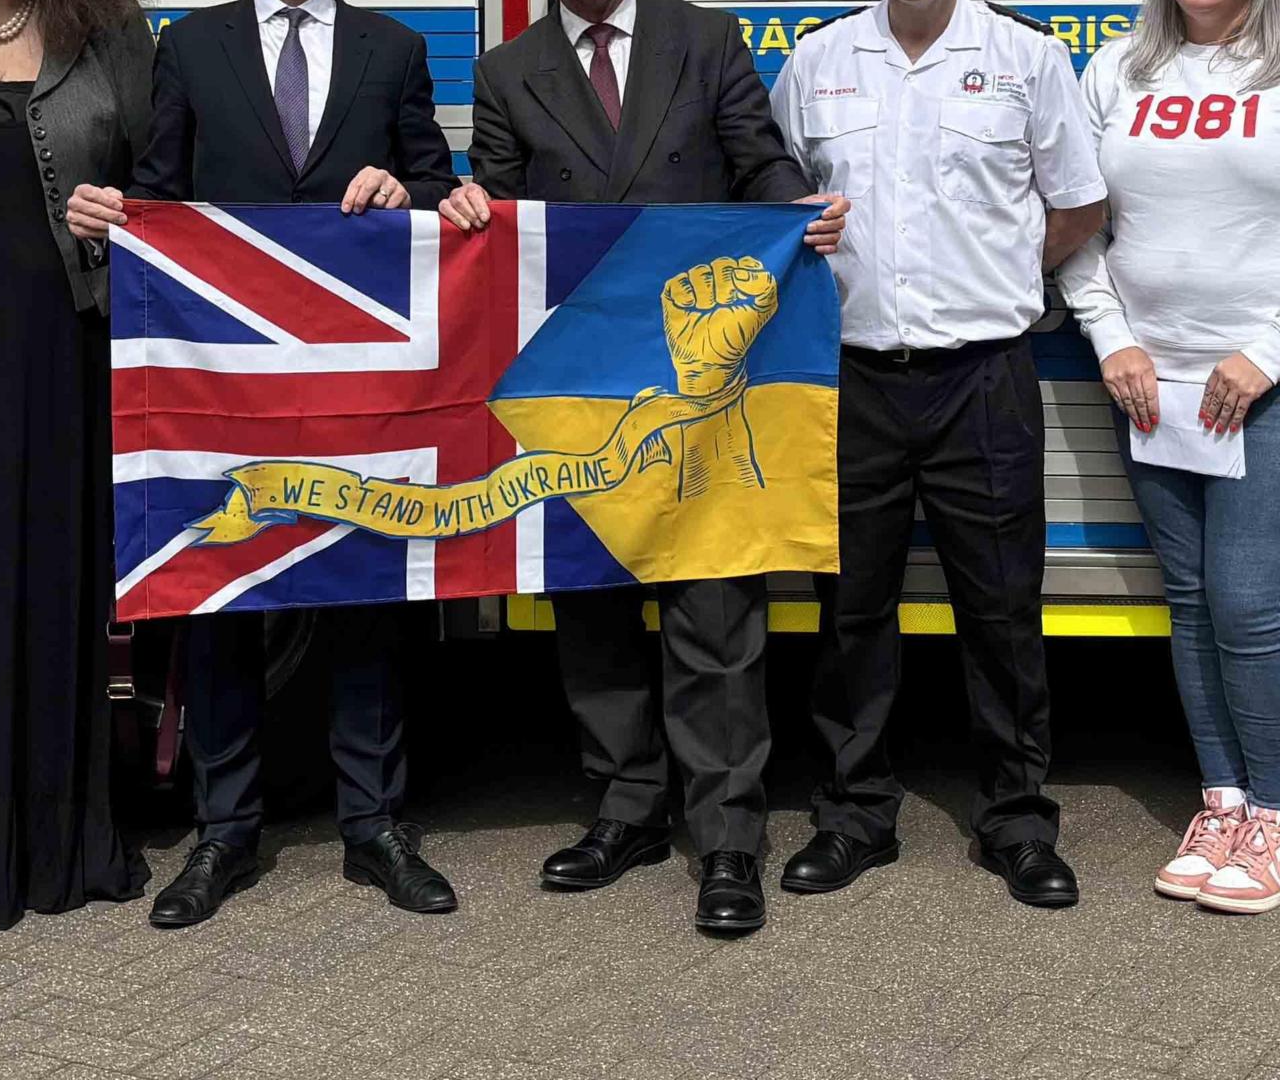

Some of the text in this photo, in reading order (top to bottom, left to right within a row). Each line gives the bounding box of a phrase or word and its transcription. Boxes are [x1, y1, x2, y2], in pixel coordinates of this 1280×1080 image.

[1128, 94, 1260, 140] 1981
[283, 457, 618, 531] WE STAND WITH UKRAINE
